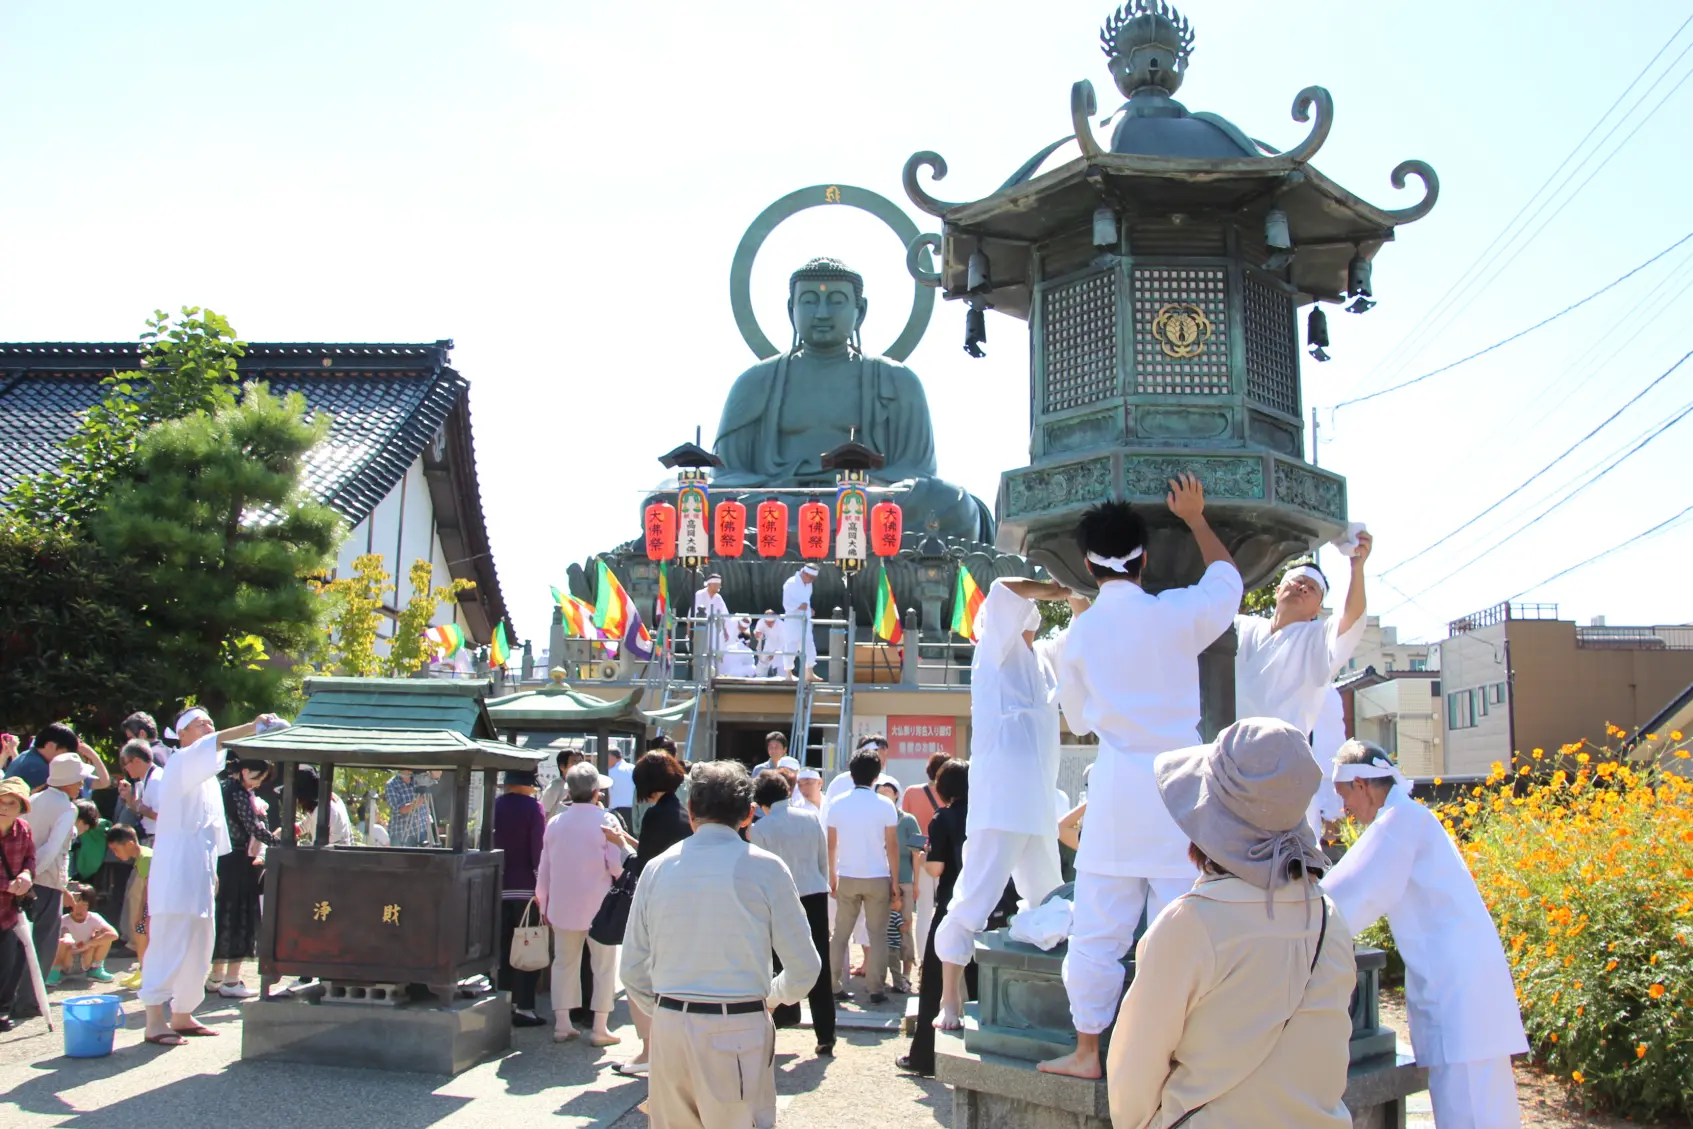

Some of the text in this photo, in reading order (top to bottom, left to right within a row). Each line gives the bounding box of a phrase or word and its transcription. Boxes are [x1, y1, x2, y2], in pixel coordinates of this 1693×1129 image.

[720, 506, 737, 547] 大佛祭
[761, 506, 778, 547] 大佛祭
[808, 507, 824, 548] 大佛祭
[882, 507, 897, 547] 大佛祭
